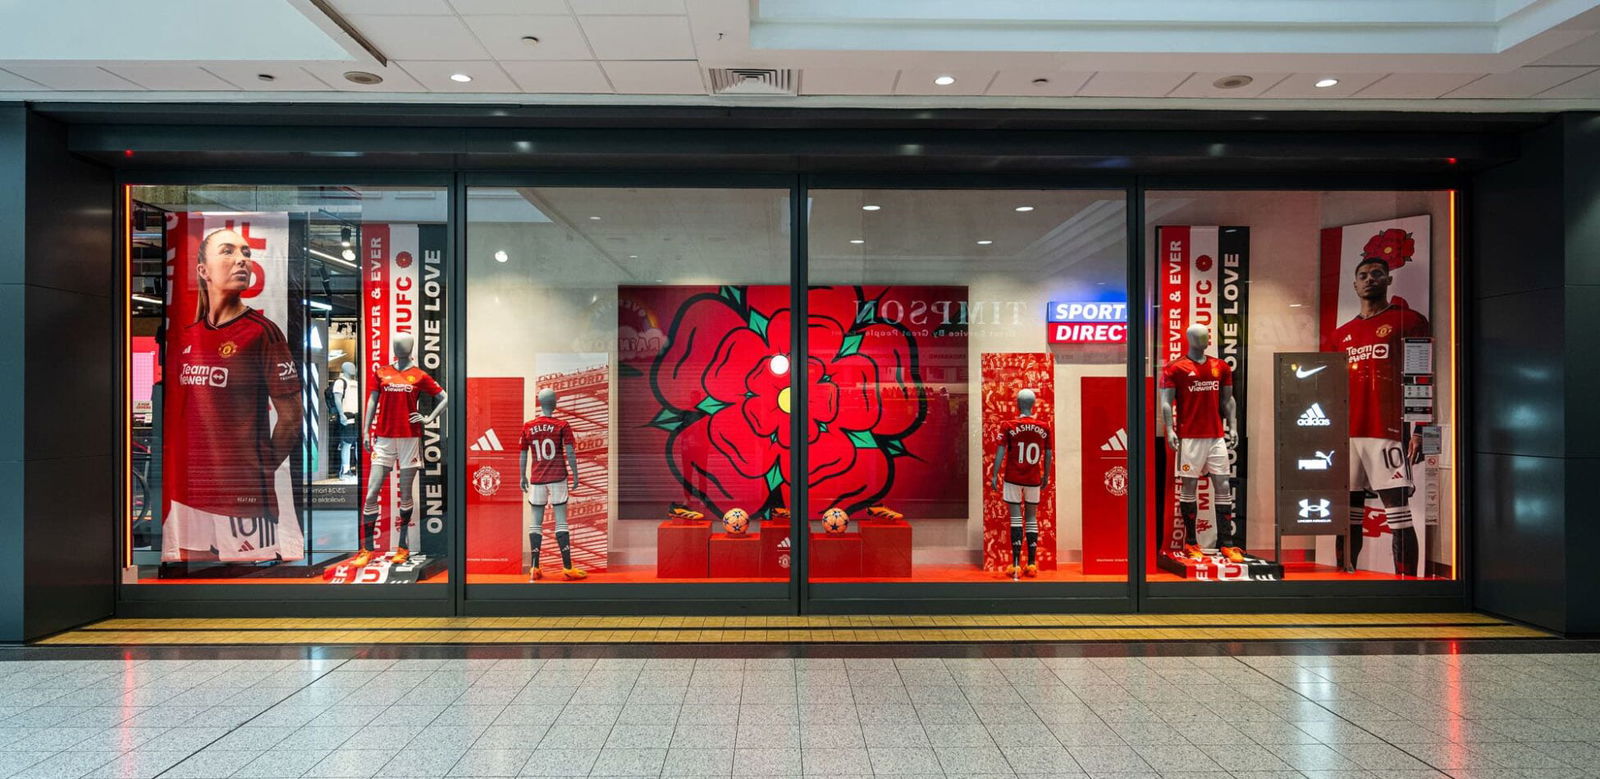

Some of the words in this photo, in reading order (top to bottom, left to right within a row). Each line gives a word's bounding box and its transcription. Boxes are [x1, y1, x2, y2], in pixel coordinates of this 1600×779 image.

[370, 237, 382, 281] EVER
[1169, 240, 1182, 285] EVER
[424, 250, 441, 311] LOVE
[1223, 253, 1239, 314] LOVE
[371, 287, 381, 299] &
[1169, 290, 1182, 302] &
[1056, 303, 1127, 320] SPORT
[371, 306, 382, 373] OREVER
[423, 319, 441, 370] ONE
[1056, 325, 1127, 341] DIREC
[1169, 308, 1182, 362] REVER
[1346, 344, 1372, 356] Team
[182, 363, 210, 375] Team
[529, 423, 554, 435] ZELEM
[1009, 424, 1048, 439] RASHFORD
[1297, 417, 1331, 426] adidas
[424, 415, 442, 476] LOVE
[532, 438, 556, 462] 10
[1017, 441, 1040, 465] 10
[1382, 446, 1403, 469] 10
[425, 484, 443, 533] ONE
